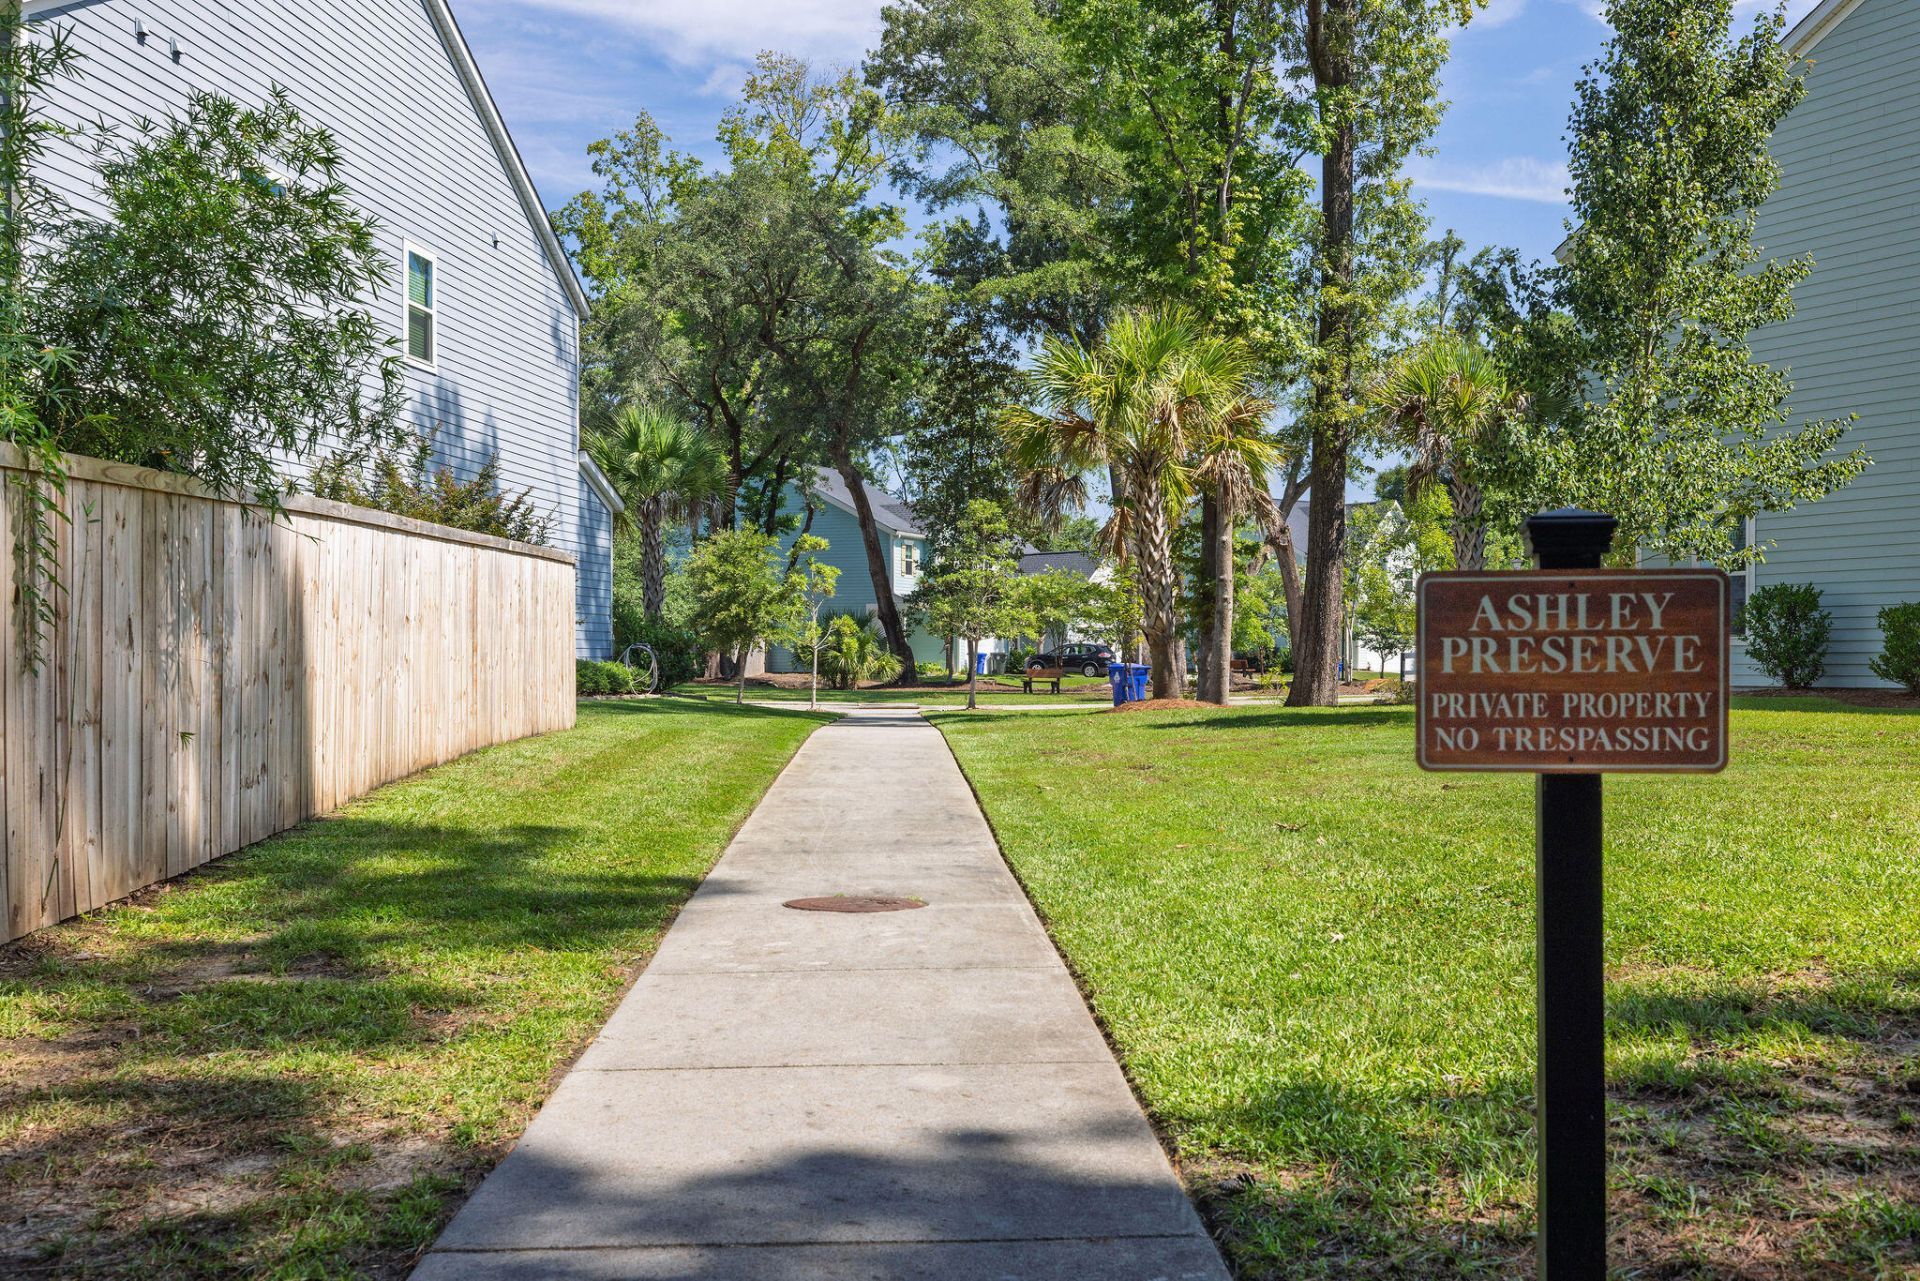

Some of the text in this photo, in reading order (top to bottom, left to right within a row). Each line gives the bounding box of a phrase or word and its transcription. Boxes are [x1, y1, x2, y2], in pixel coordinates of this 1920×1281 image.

[1469, 592, 1675, 631] ASHLEY
[1440, 635, 1704, 674] PRESERVE
[1432, 692, 1713, 718] PRIVATE PROPERTY
[1435, 727, 1709, 751] NO TRESPASSING
